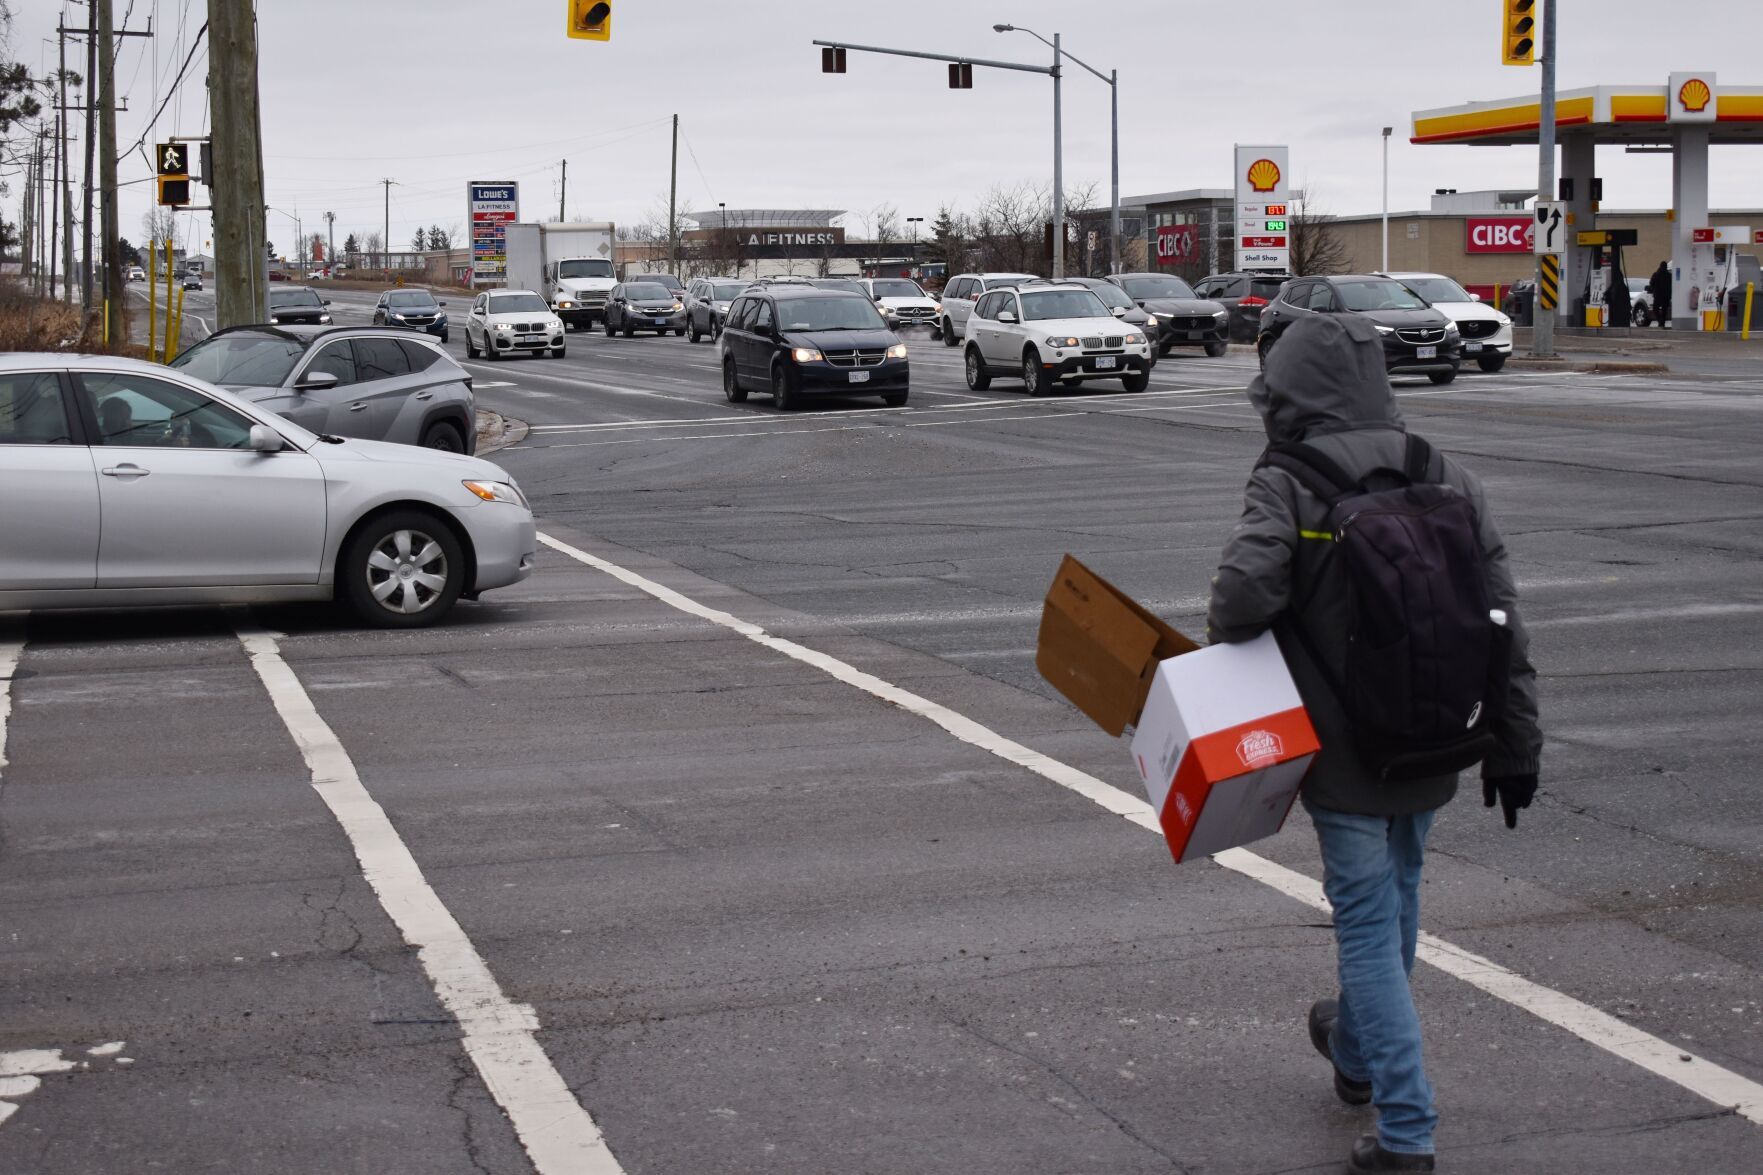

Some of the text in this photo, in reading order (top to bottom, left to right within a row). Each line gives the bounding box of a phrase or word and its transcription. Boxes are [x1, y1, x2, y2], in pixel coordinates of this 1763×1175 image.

[767, 233, 834, 246] FITNESS
[1158, 233, 1180, 257] CIBC
[1473, 225, 1522, 246] CIBC
[1262, 254, 1278, 263] Shop
[1242, 735, 1274, 755] Fresh
